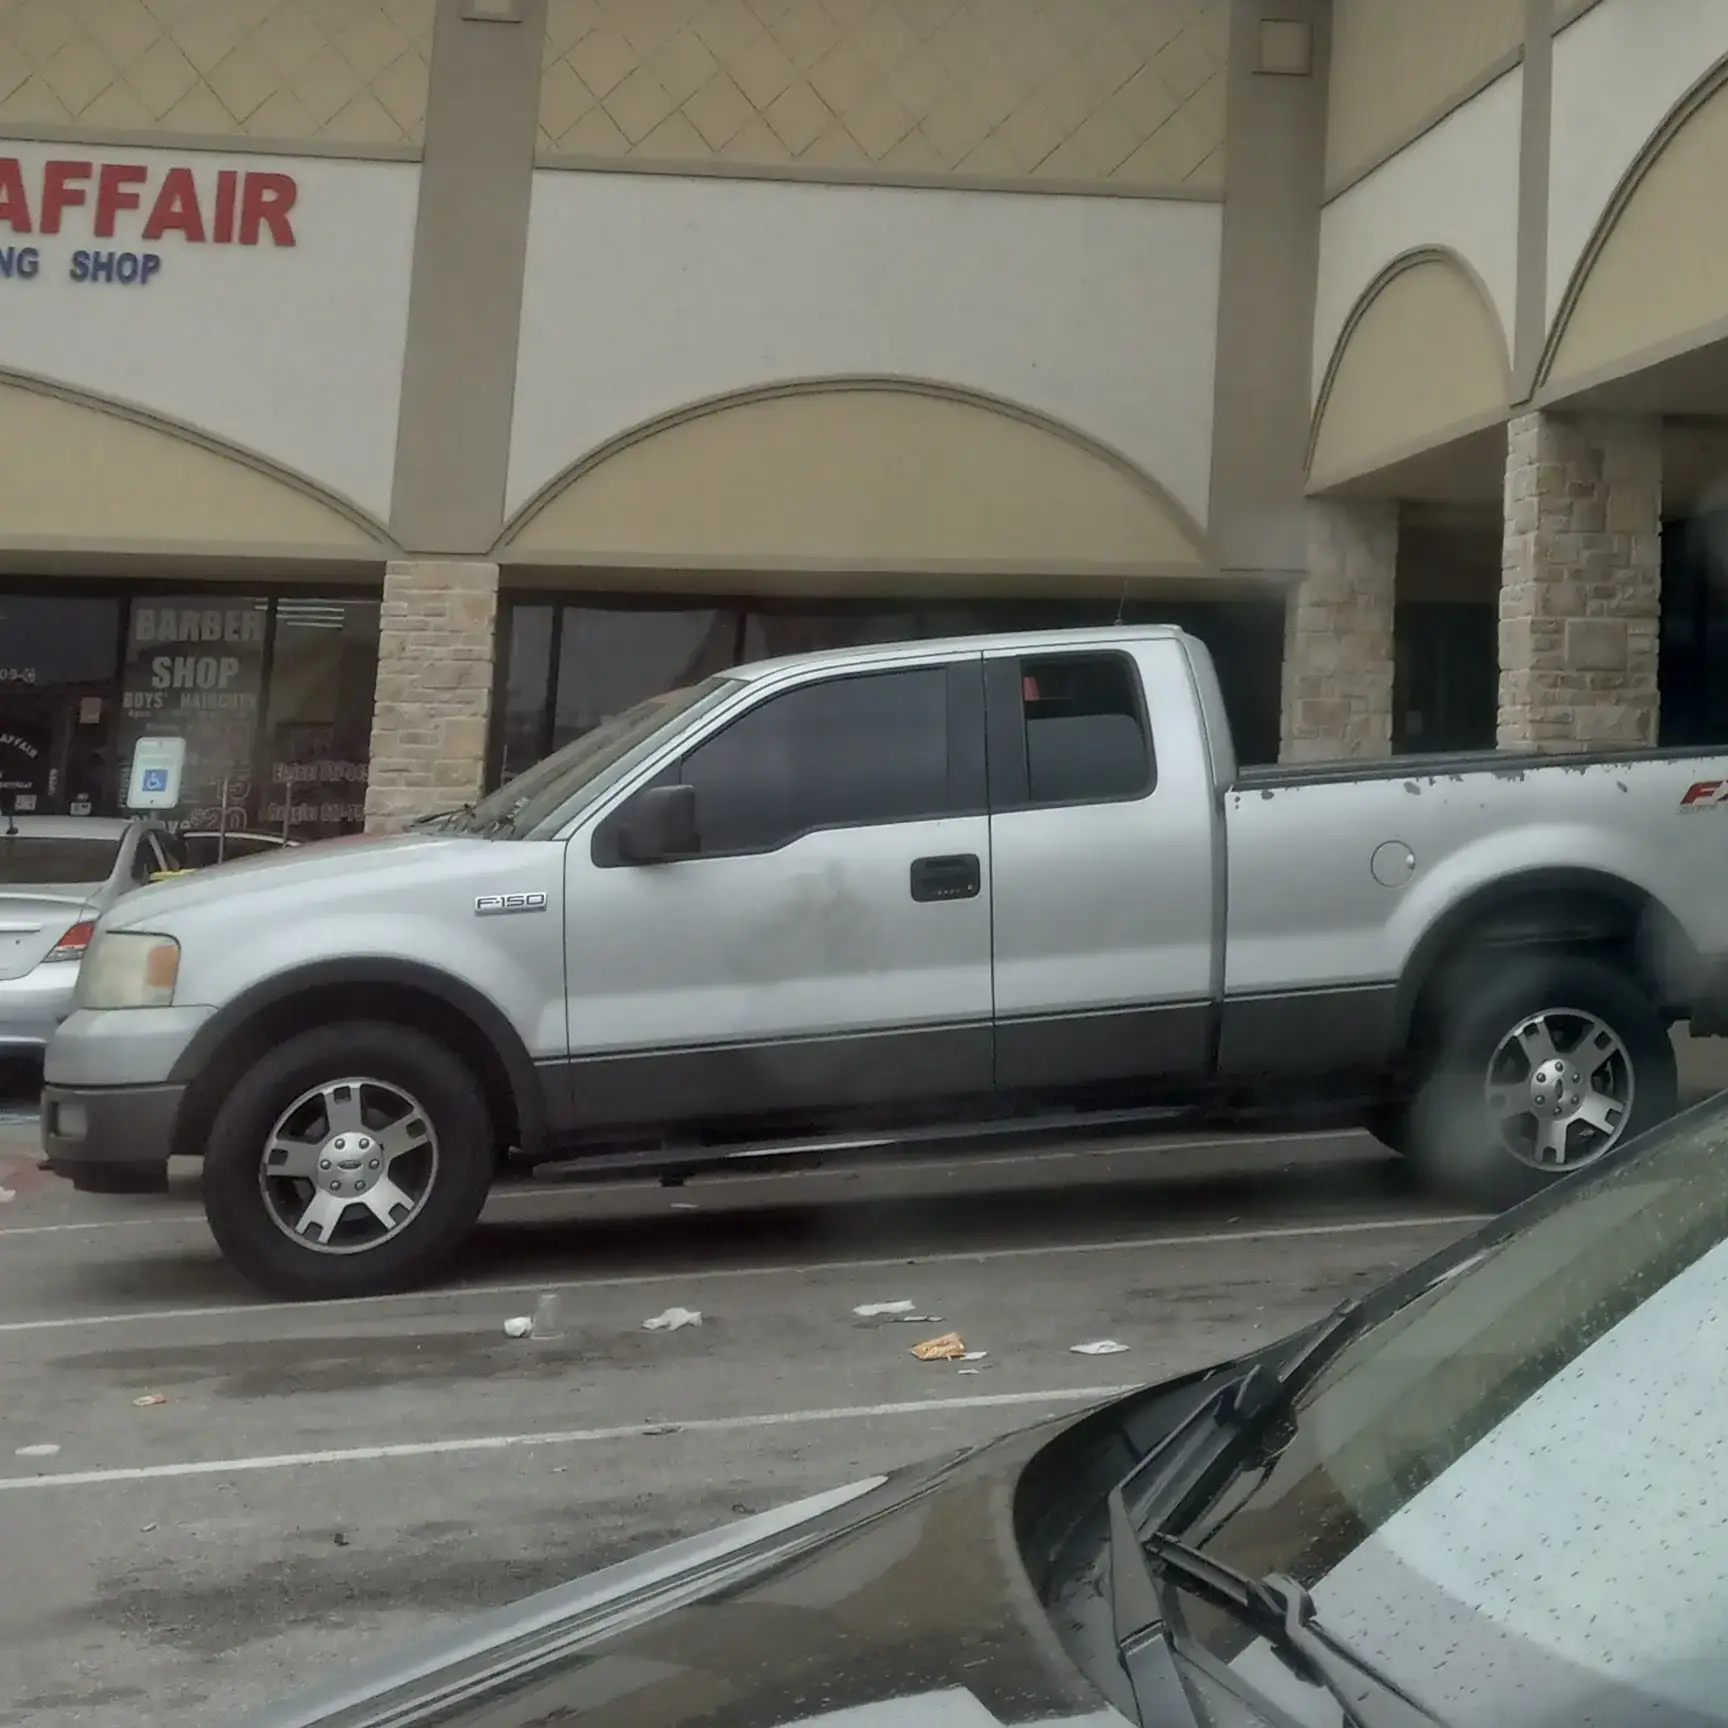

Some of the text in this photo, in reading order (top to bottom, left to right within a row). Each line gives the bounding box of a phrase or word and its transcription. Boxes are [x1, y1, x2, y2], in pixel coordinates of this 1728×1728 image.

[0, 157, 298, 247] AFFAIR
[70, 250, 161, 285] SHOP
[136, 608, 262, 642] BARBER
[151, 656, 240, 690] SHOP
[477, 893, 545, 909] F-150
